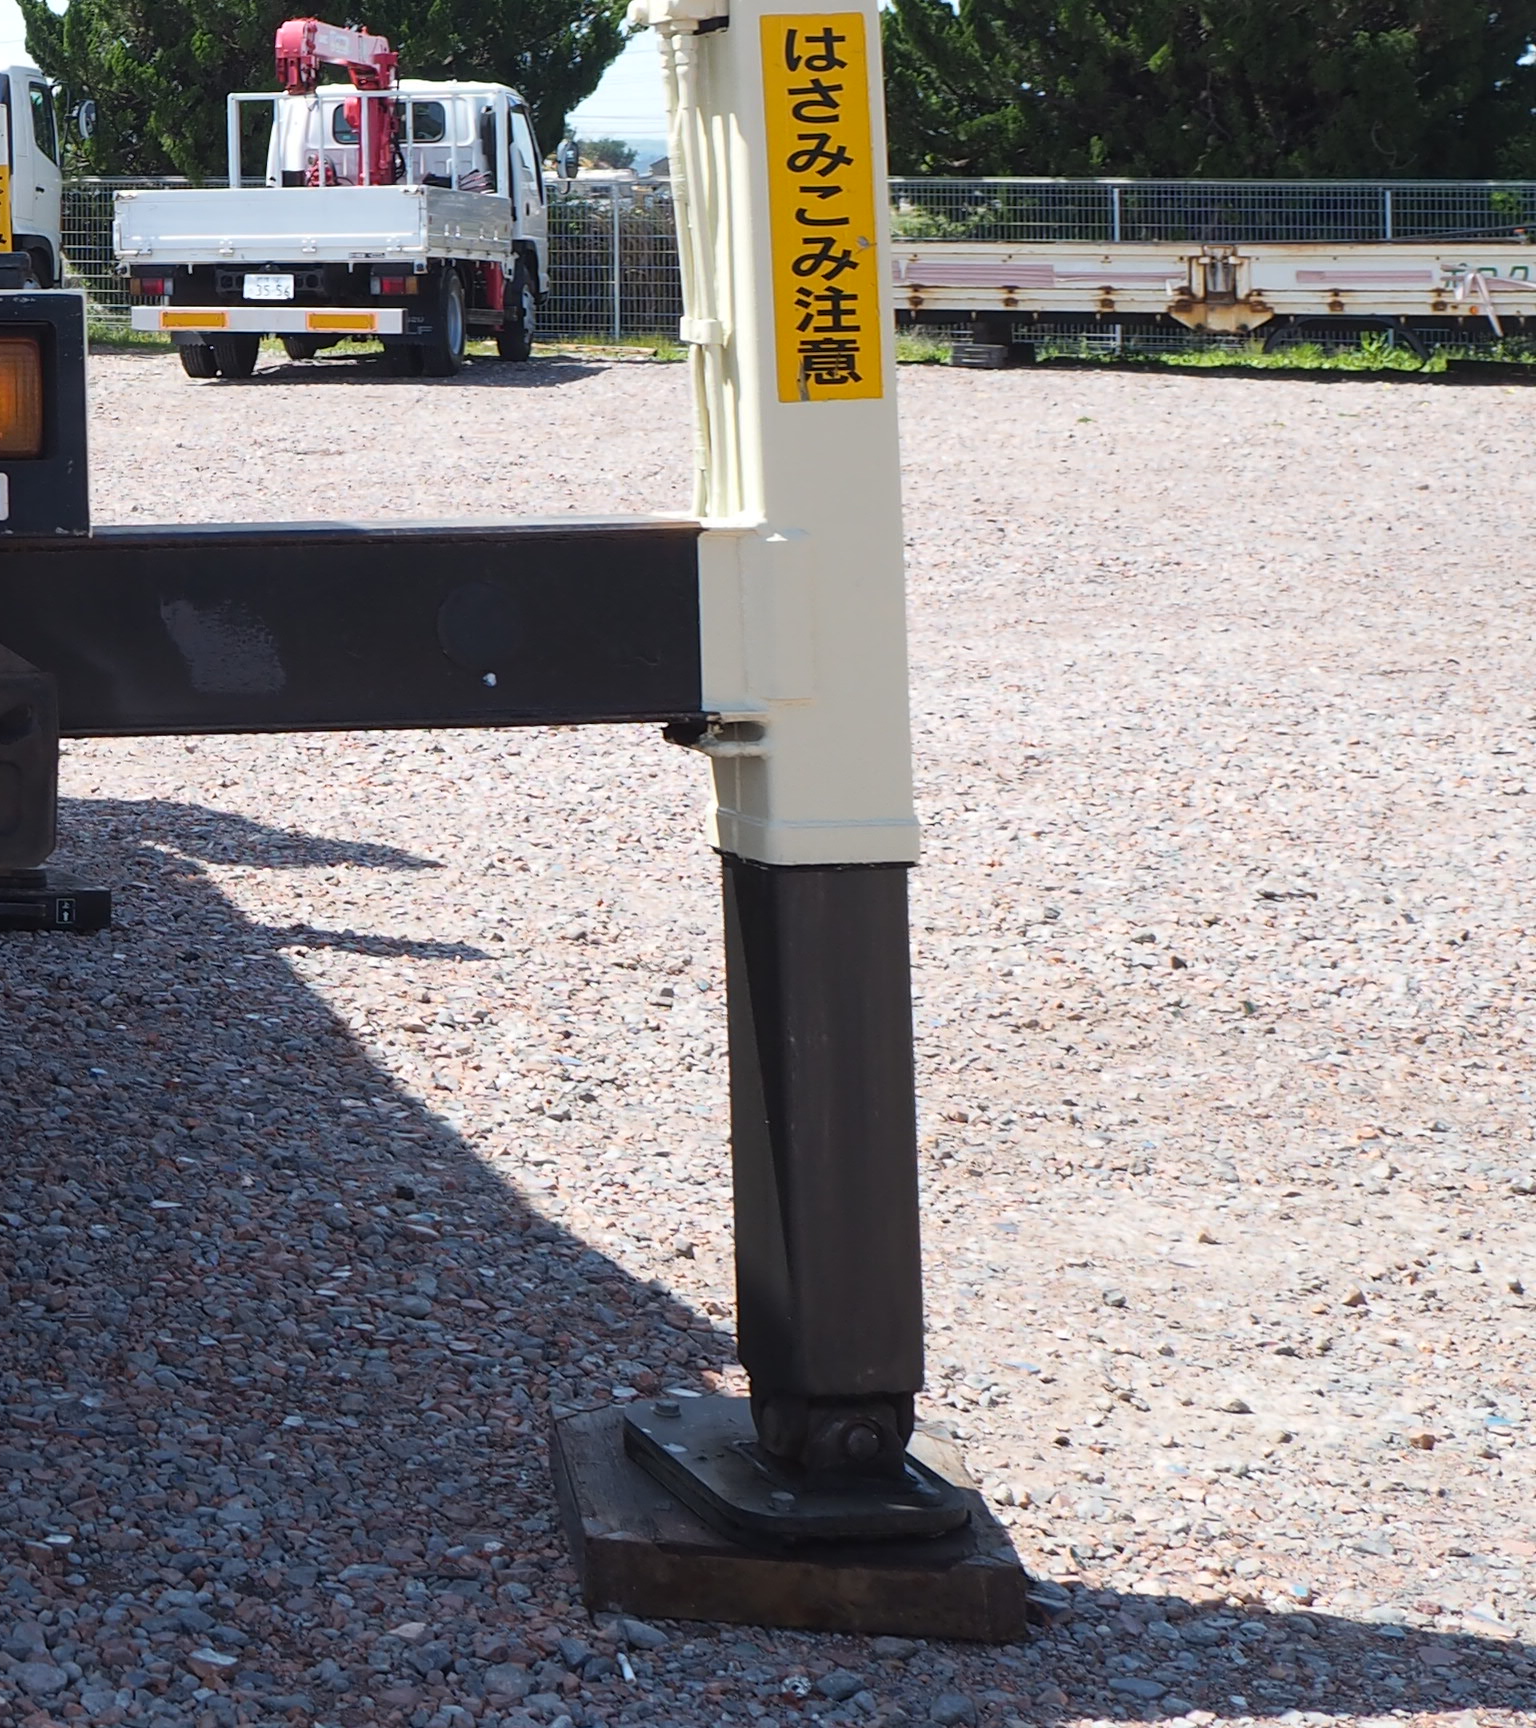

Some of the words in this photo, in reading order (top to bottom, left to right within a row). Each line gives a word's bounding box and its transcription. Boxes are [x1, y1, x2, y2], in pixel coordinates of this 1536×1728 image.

[784, 27, 864, 386] はさみこみ注意
